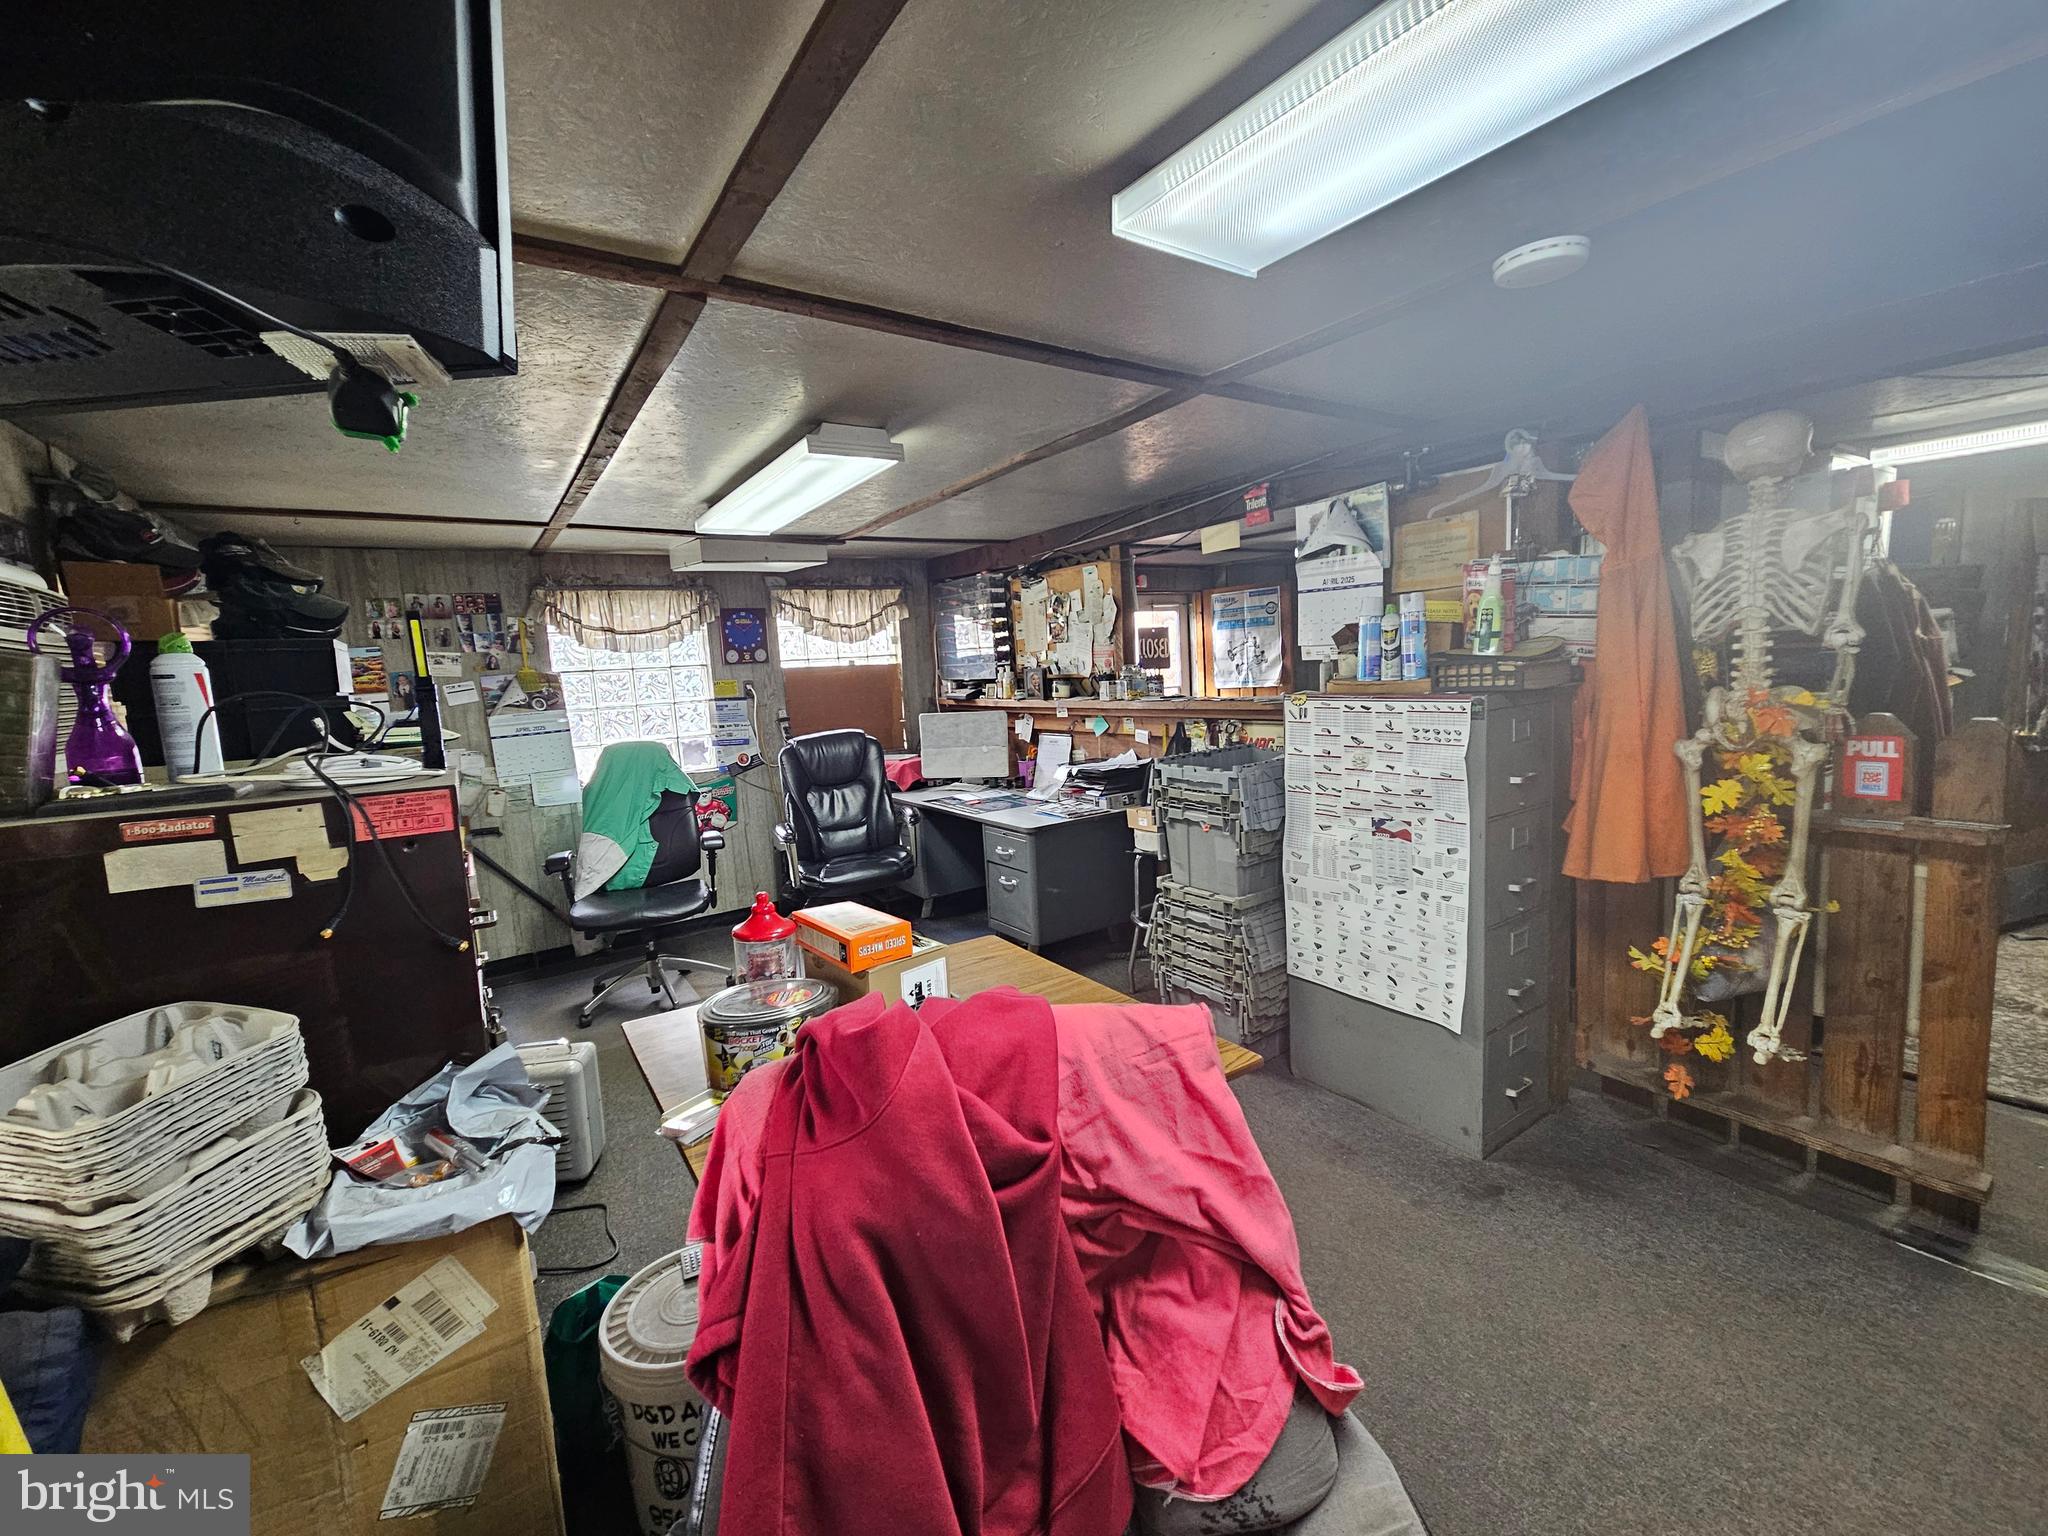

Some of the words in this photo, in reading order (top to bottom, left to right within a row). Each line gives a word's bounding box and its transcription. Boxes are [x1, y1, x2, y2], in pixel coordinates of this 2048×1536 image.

[1846, 739, 1900, 758] PULL
[126, 820, 211, 836] 1-800-Radiator
[858, 942, 884, 957] WAFERS
[885, 935, 906, 950] SPICED
[631, 1403, 675, 1425] D&D
[682, 1401, 702, 1422] A
[651, 1430, 681, 1449] WE
[683, 1428, 699, 1446] C
